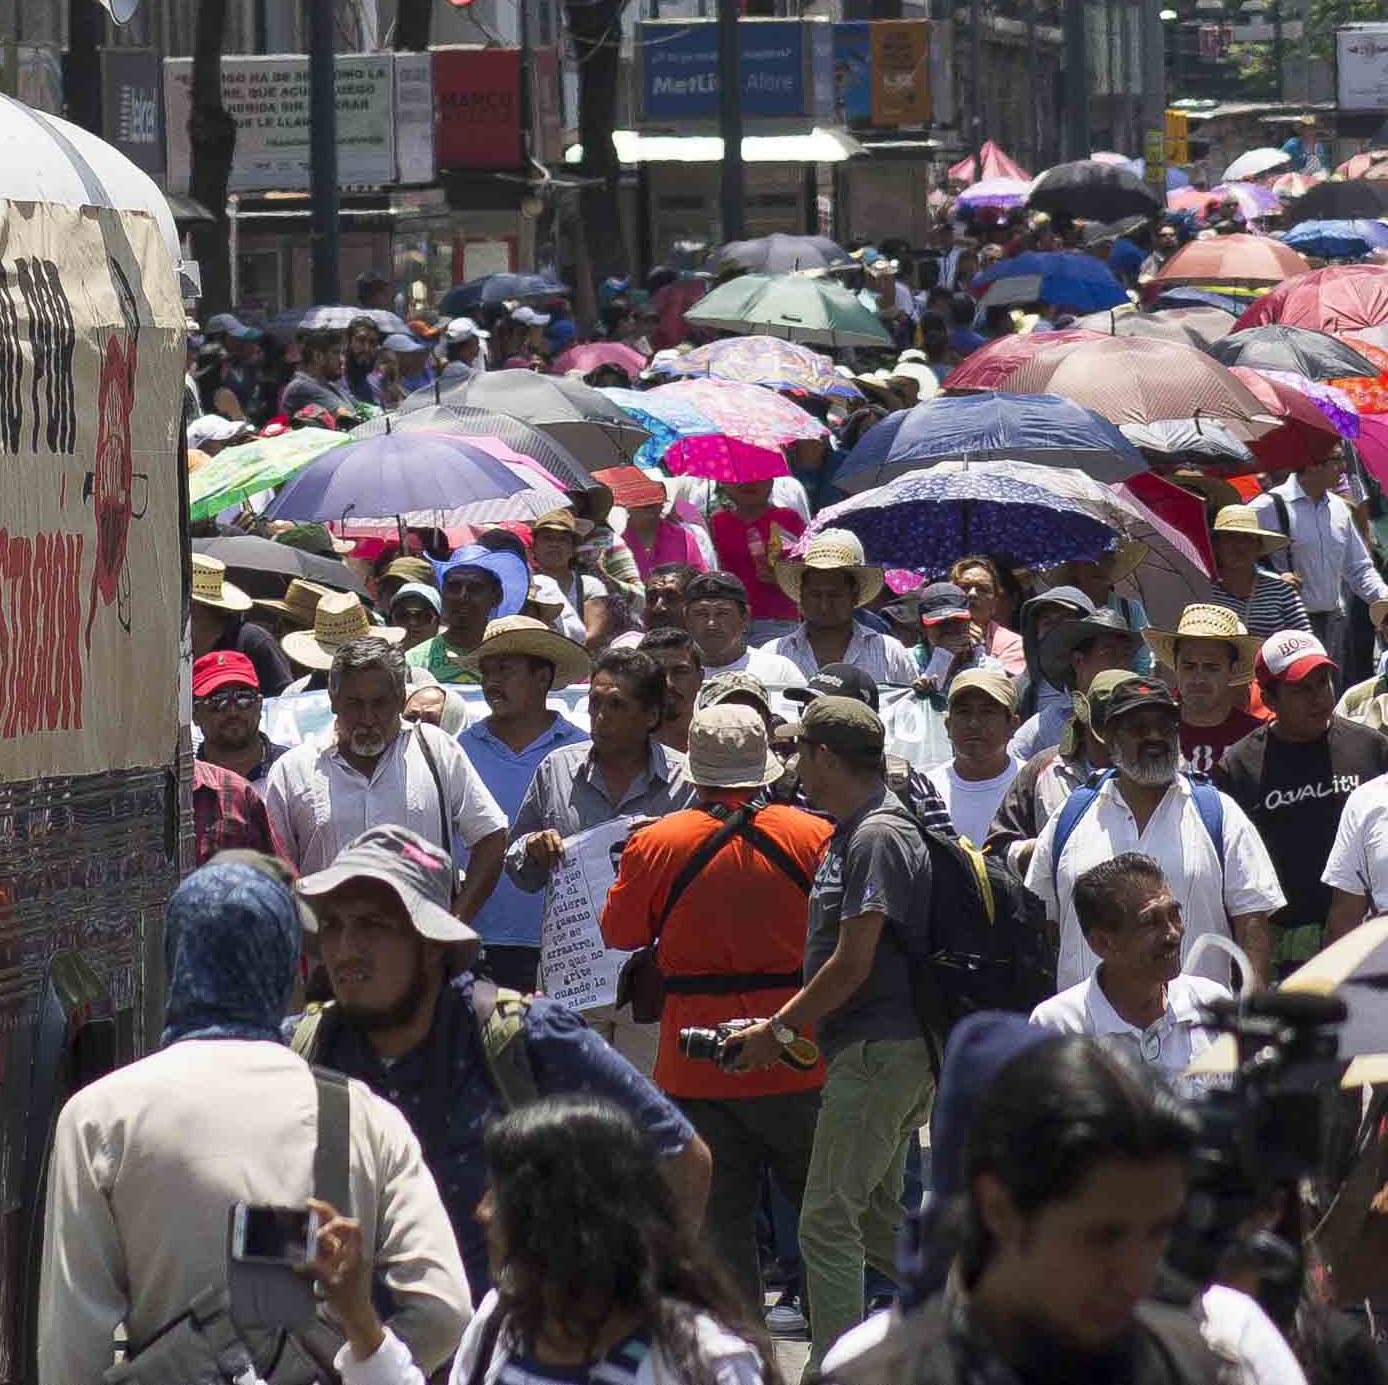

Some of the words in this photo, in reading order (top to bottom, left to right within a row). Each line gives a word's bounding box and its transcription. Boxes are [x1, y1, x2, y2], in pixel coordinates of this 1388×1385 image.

[555, 910, 591, 931] gusano
[567, 954, 588, 969] que
[590, 949, 604, 961] no
[562, 967, 592, 986] grite
[594, 977, 607, 988] lo
